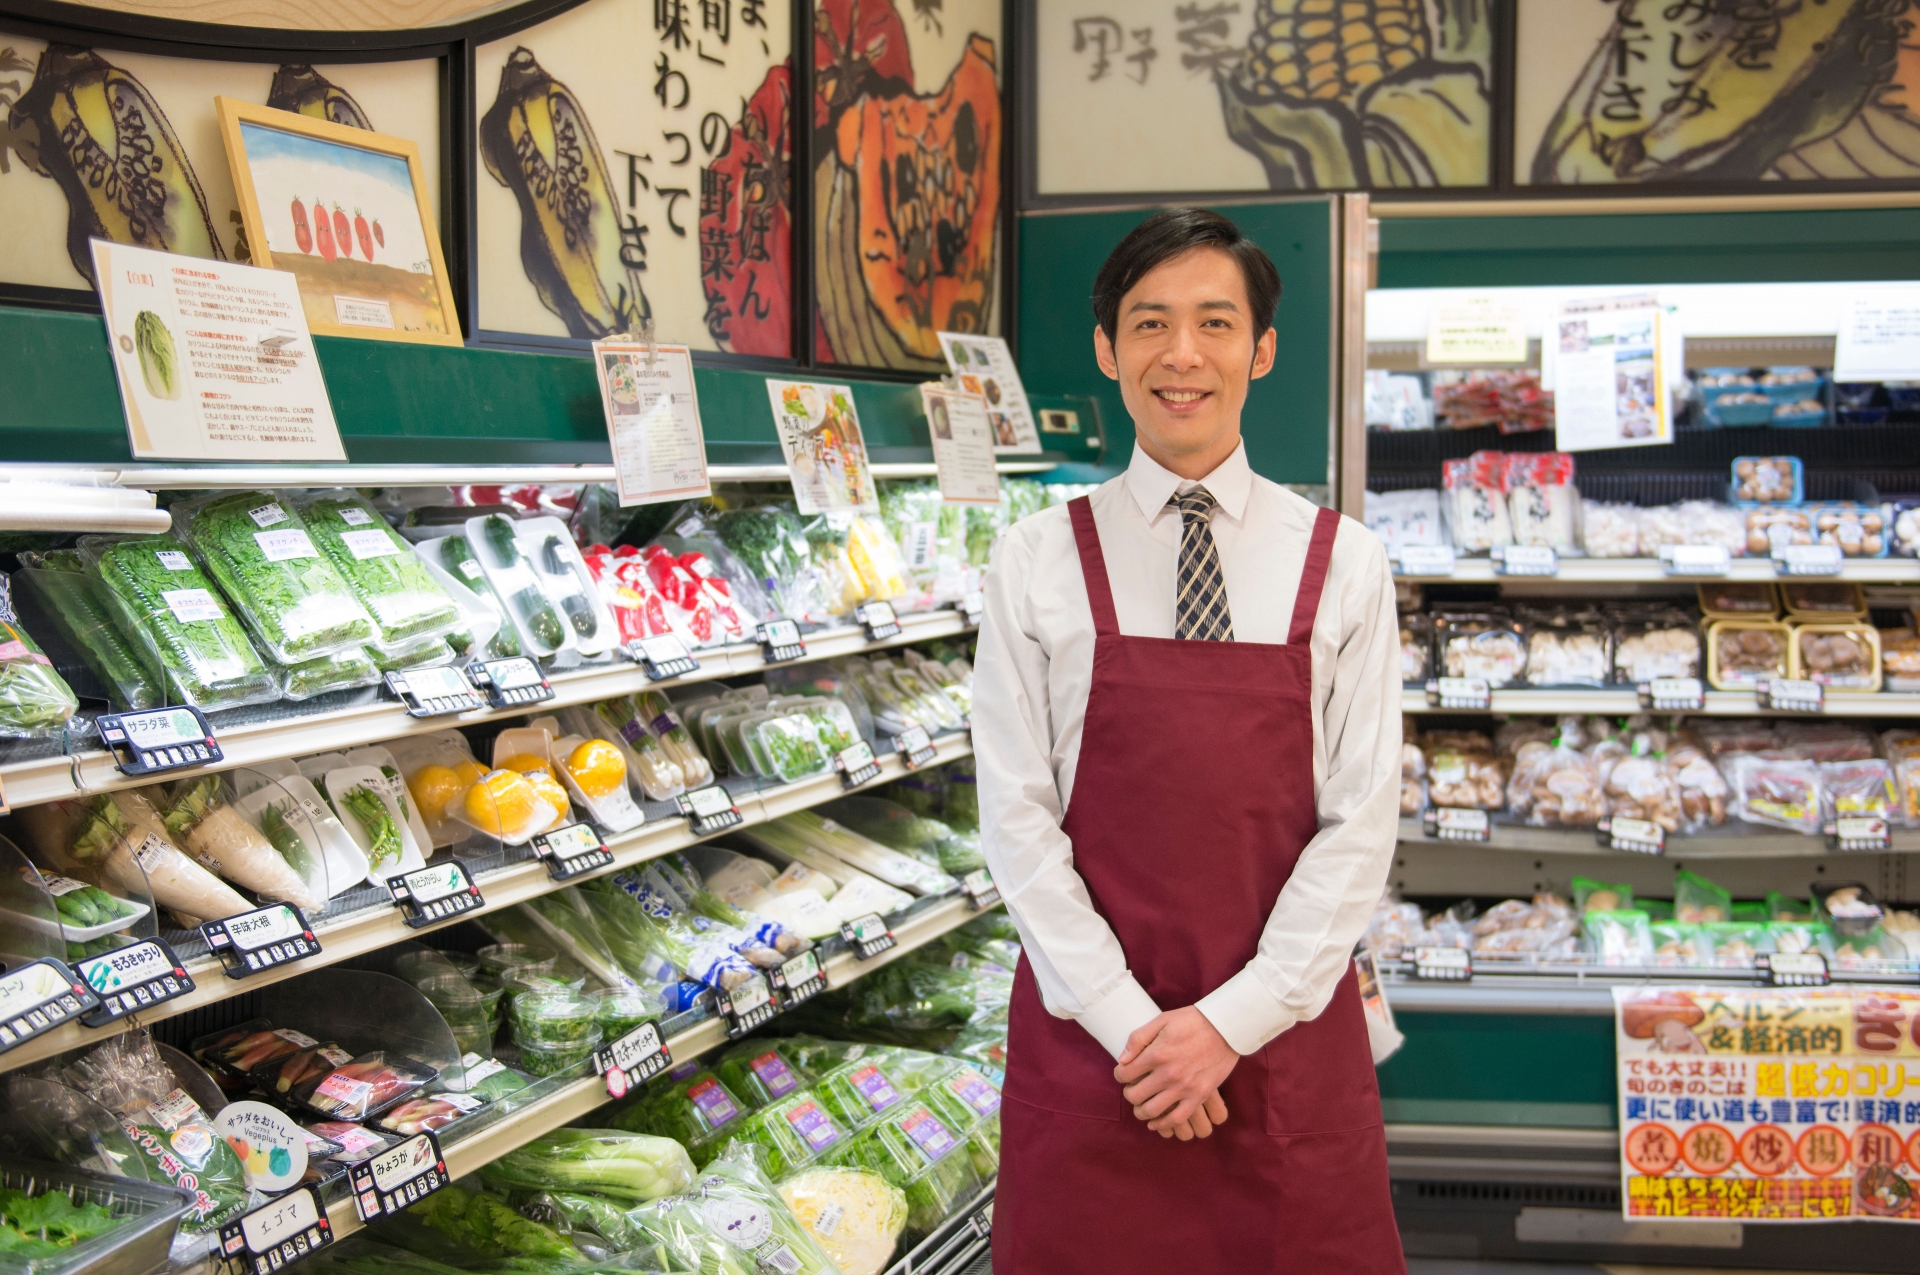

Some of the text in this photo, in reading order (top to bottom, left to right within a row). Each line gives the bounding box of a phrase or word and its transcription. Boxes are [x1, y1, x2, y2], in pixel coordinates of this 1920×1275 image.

[613, 148, 656, 333] 下さい
[127, 716, 171, 733] サラダ菜
[230, 914, 272, 935] 辛味大根
[111, 945, 161, 972] もろきゅうり
[272, 939, 306, 958] 175
[136, 978, 177, 1001] 248
[33, 997, 77, 1024] 148
[1627, 1078, 1746, 1095] 旬のきのこは
[244, 1127, 277, 1144] Vegeplus
[375, 1149, 408, 1176] みょうが
[406, 1172, 437, 1197] 158
[261, 1203, 298, 1235] エゴマ
[271, 1236, 306, 1265] 128
